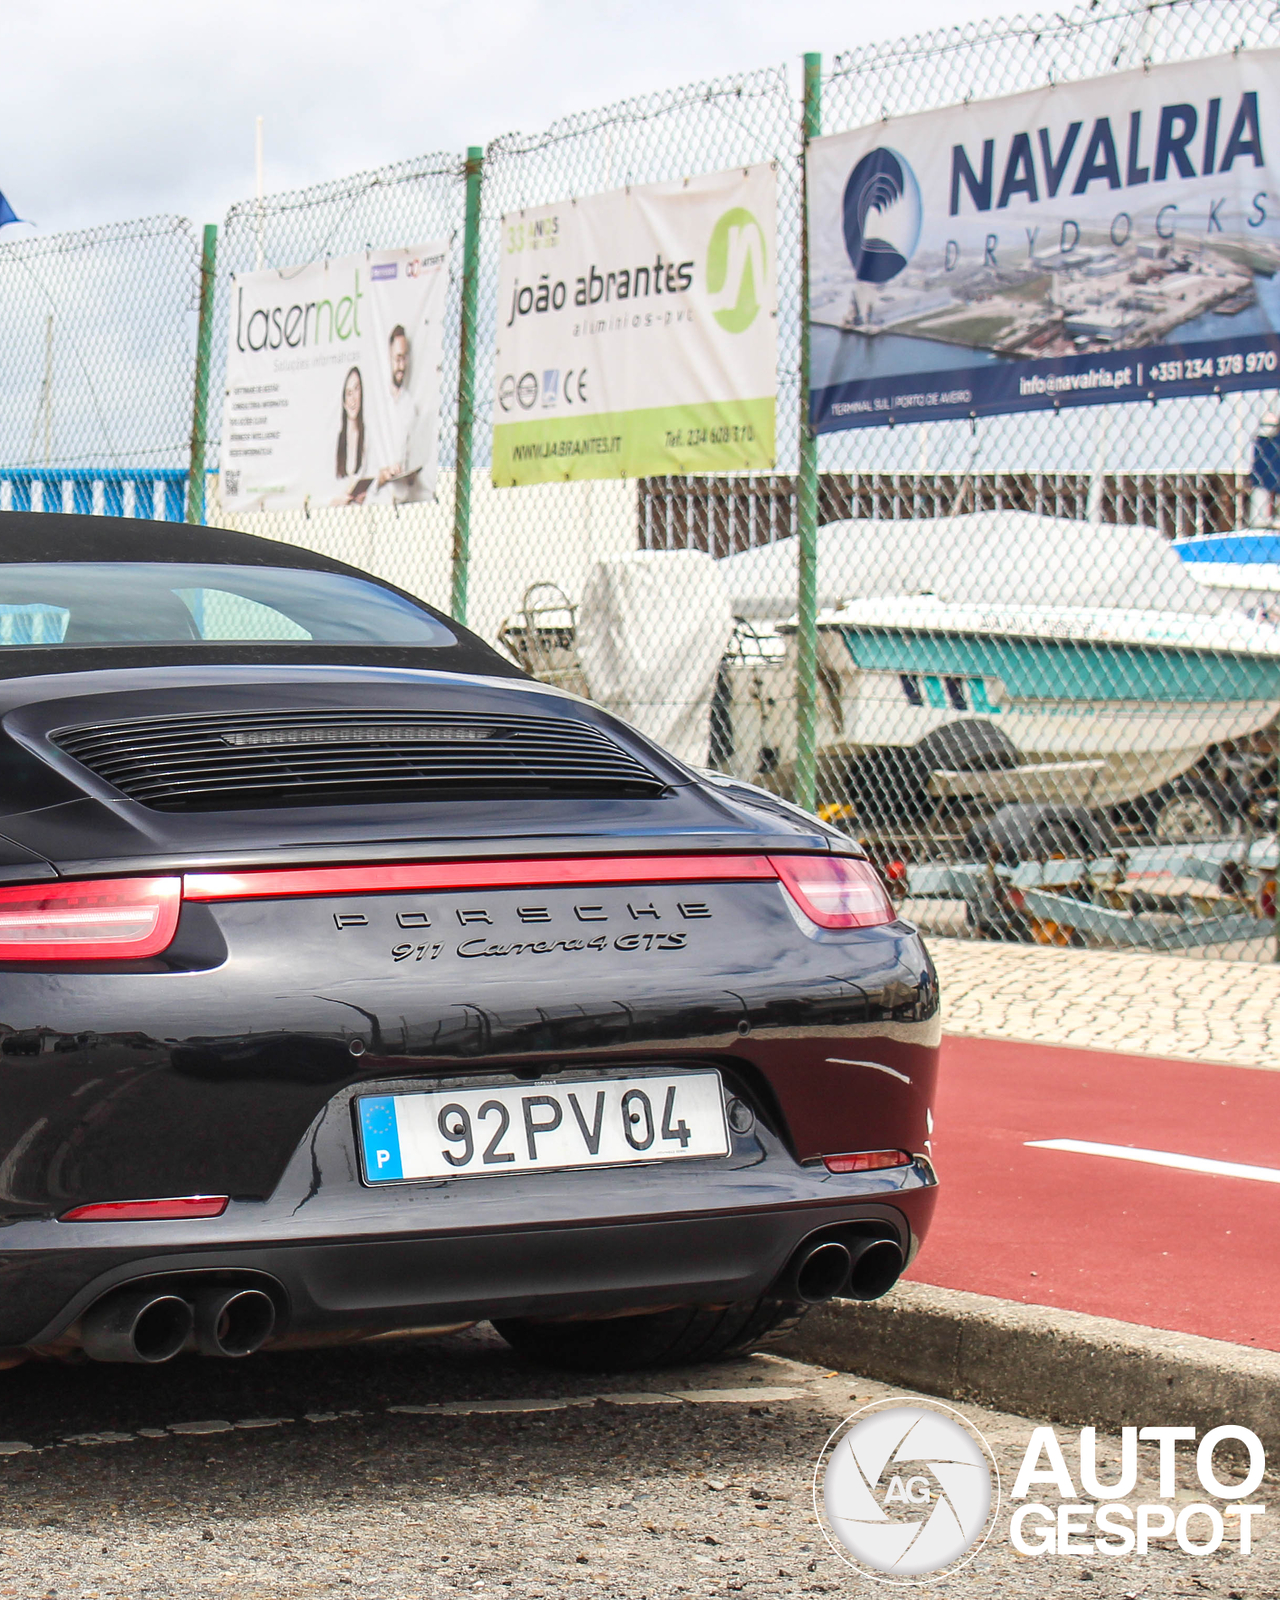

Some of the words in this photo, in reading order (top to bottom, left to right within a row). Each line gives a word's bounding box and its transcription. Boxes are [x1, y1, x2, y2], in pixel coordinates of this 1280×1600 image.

[950, 91, 1264, 216] NAVALRIA
[944, 190, 1268, 272] DRYDOCKS
[237, 268, 363, 353] lasernet
[508, 272, 566, 327] joão
[574, 254, 695, 307] abrantes
[1019, 366, 1132, 397] info@navalria.pt
[1149, 360, 1183, 381] +351
[1184, 357, 1214, 379] 234
[1216, 353, 1244, 377] 378
[1245, 350, 1278, 373] 970
[831, 400, 873, 416] TERMINAL
[895, 394, 926, 409] PORTO
[333, 902, 713, 930] PORSCHE
[391, 941, 445, 962] 911
[614, 931, 689, 951] GTS
[376, 1149, 391, 1169] P
